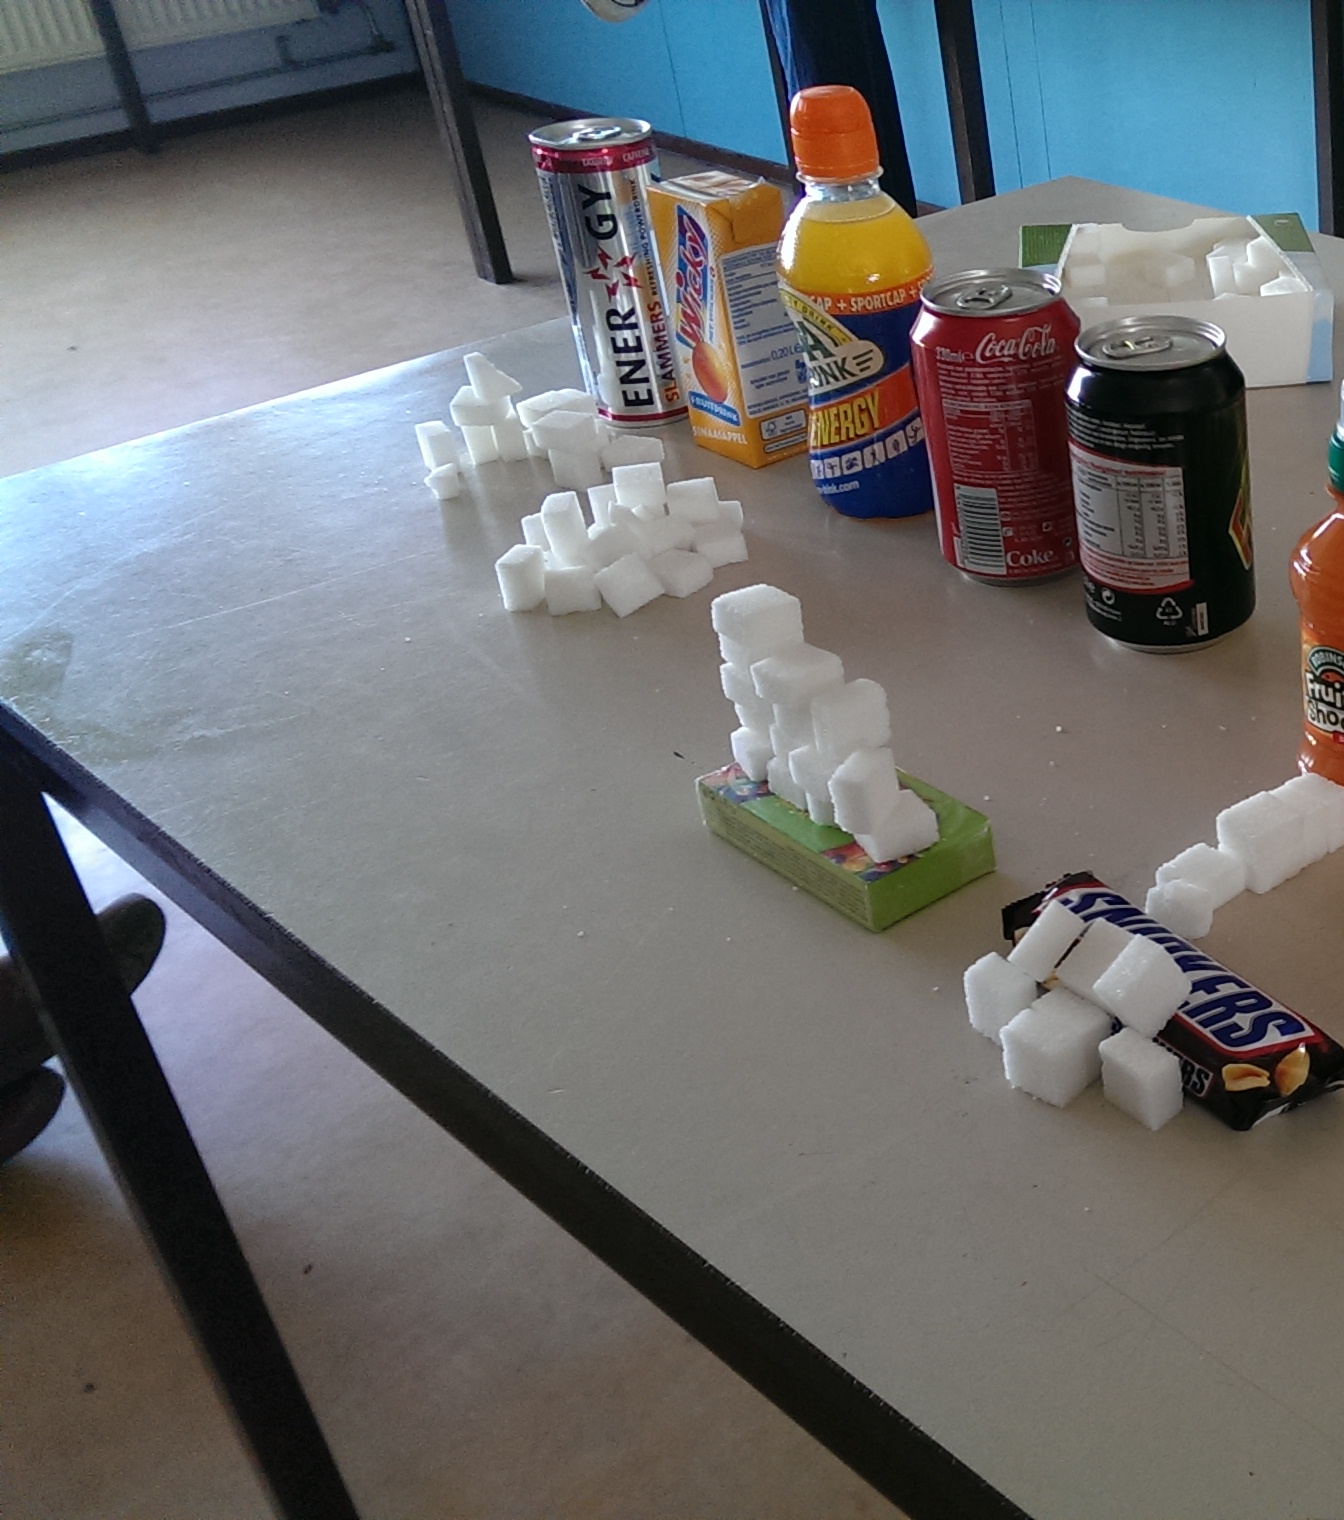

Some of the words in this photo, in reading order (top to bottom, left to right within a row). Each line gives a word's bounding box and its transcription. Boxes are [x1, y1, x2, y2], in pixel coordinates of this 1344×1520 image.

[577, 183, 619, 240] GY
[674, 213, 709, 346] Wicky
[851, 288, 906, 312] SPORTCAP
[605, 306, 655, 407] ENER
[646, 300, 681, 402] SLAMMERS
[691, 425, 748, 445] SINAASAPPEL
[810, 387, 880, 447] ENERGY
[1006, 549, 1055, 567] Coke
